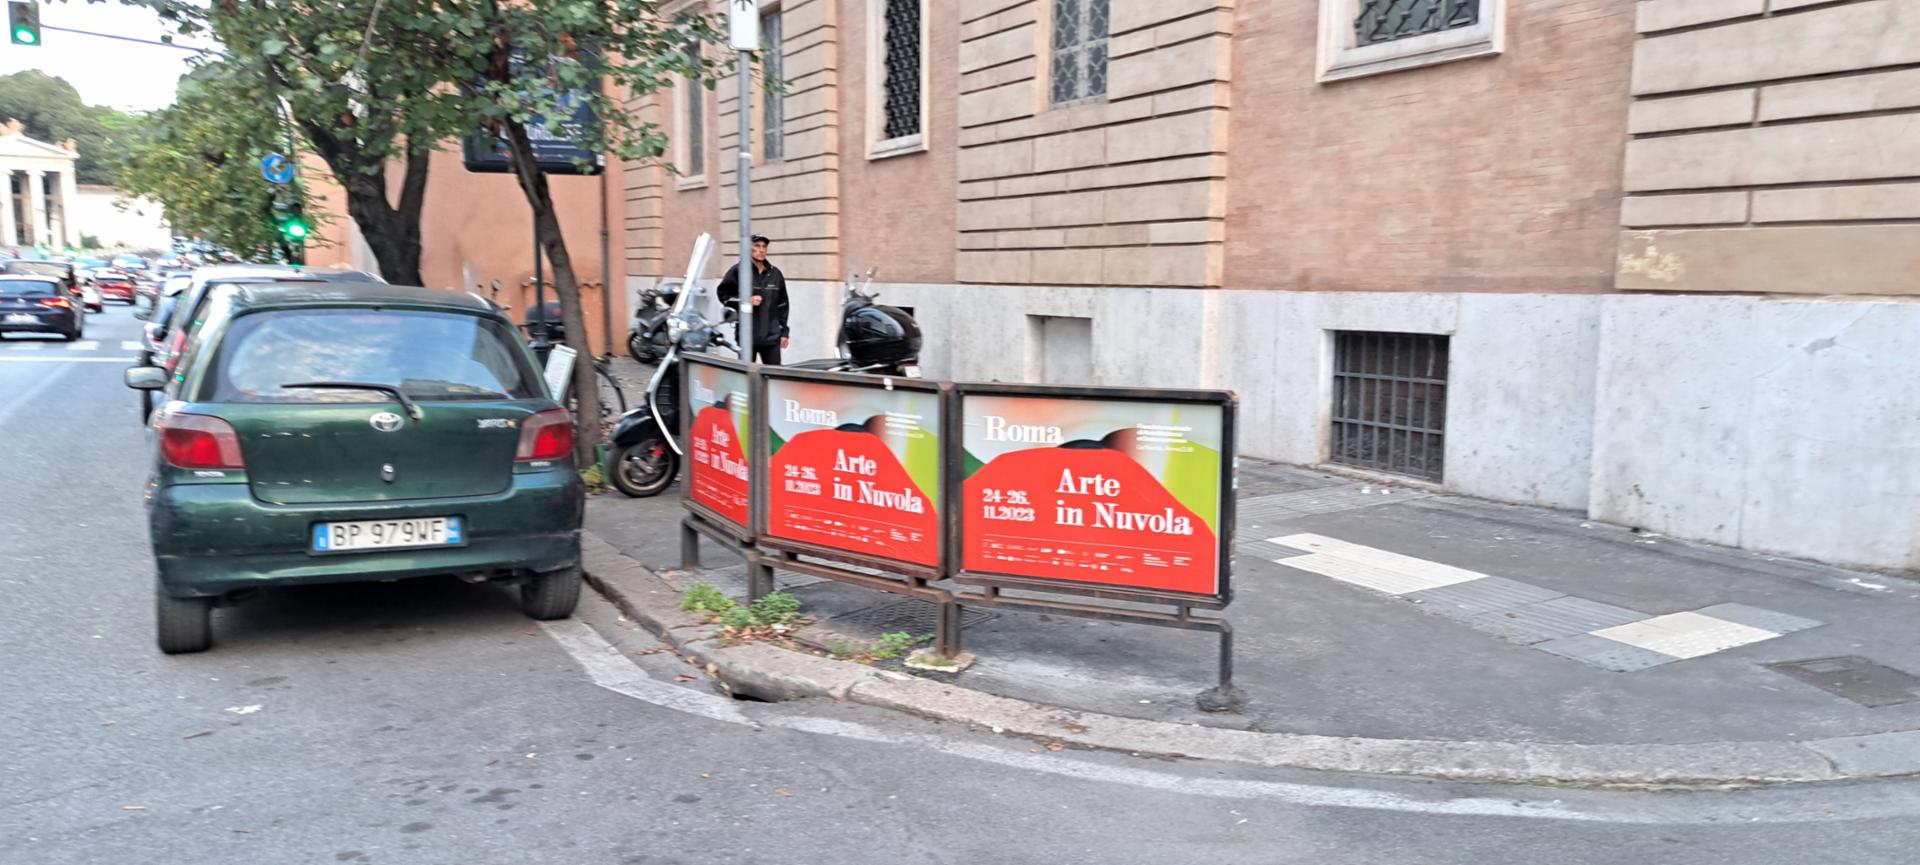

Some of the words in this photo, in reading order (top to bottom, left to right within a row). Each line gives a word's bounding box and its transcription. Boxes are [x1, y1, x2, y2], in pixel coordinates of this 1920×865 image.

[784, 399, 838, 427] Roma
[983, 415, 1064, 444] Roma
[833, 448, 878, 476] Arte
[832, 477, 855, 502] in
[857, 481, 925, 514] Nuvola
[982, 488, 1030, 505] 24-26.
[1056, 468, 1121, 497] Arte
[983, 504, 1036, 523] 11.2023
[1056, 500, 1084, 526] in
[1092, 502, 1193, 536] Nuvola
[333, 524, 362, 547] BP
[371, 520, 444, 544] 979WF
